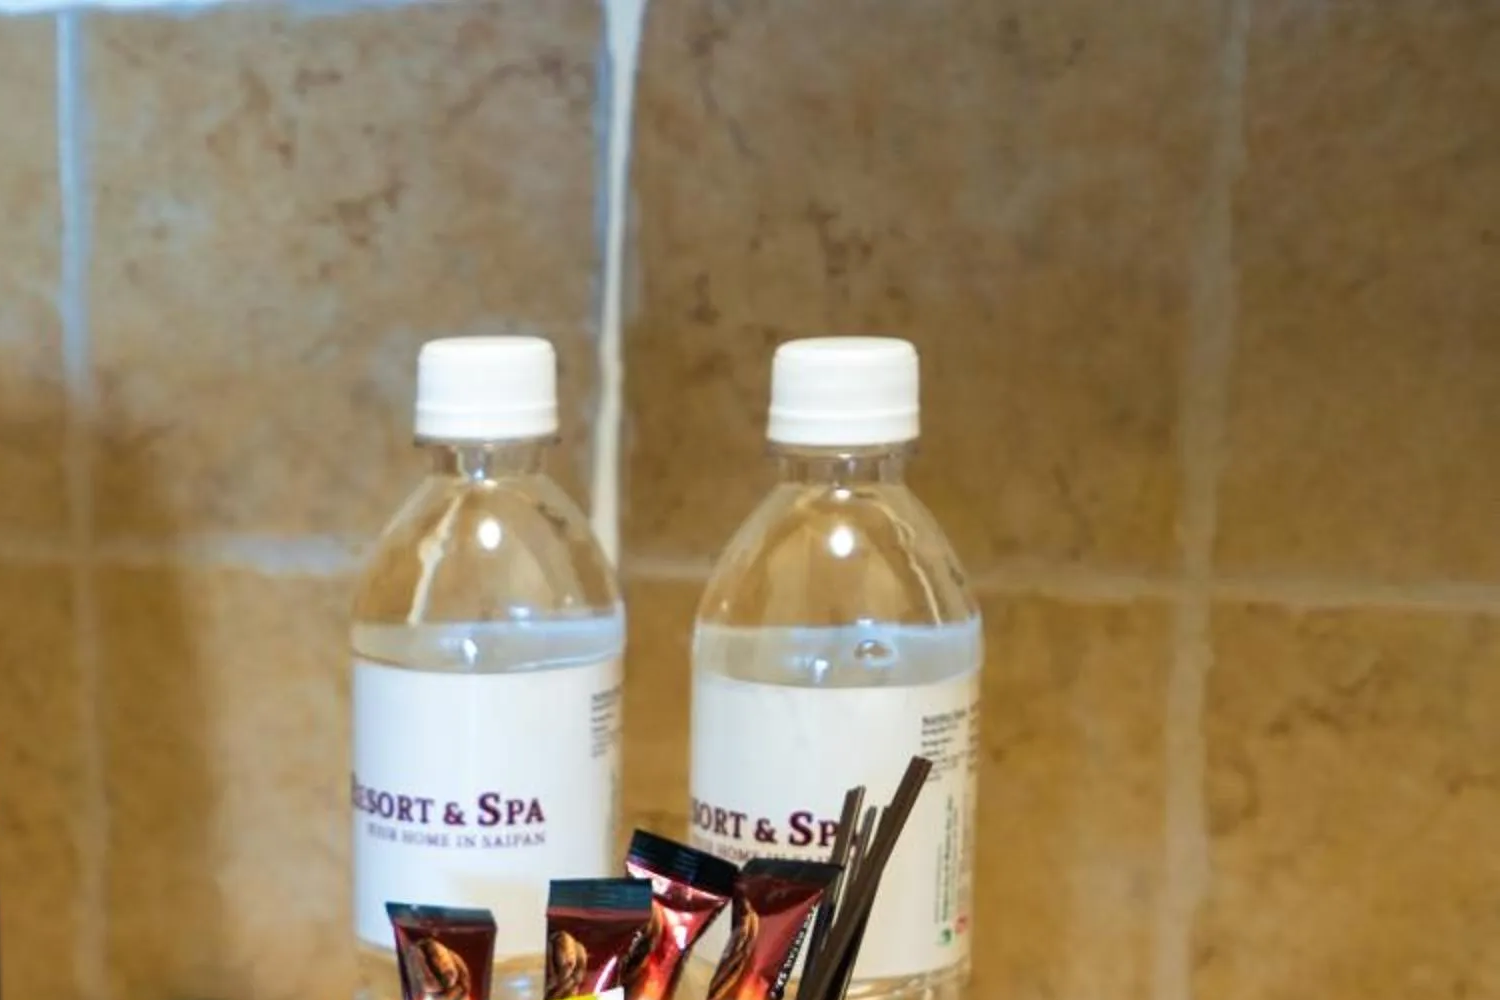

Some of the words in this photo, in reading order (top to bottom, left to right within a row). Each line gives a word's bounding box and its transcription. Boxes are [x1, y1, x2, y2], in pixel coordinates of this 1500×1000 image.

[351, 770, 434, 824] ESORT
[443, 801, 466, 826] &
[477, 791, 545, 827] SPA
[402, 828, 448, 848] HOME
[456, 834, 476, 848] IN
[481, 832, 545, 849] SAIPAN
[754, 817, 777, 844] &
[788, 810, 840, 847] SP
